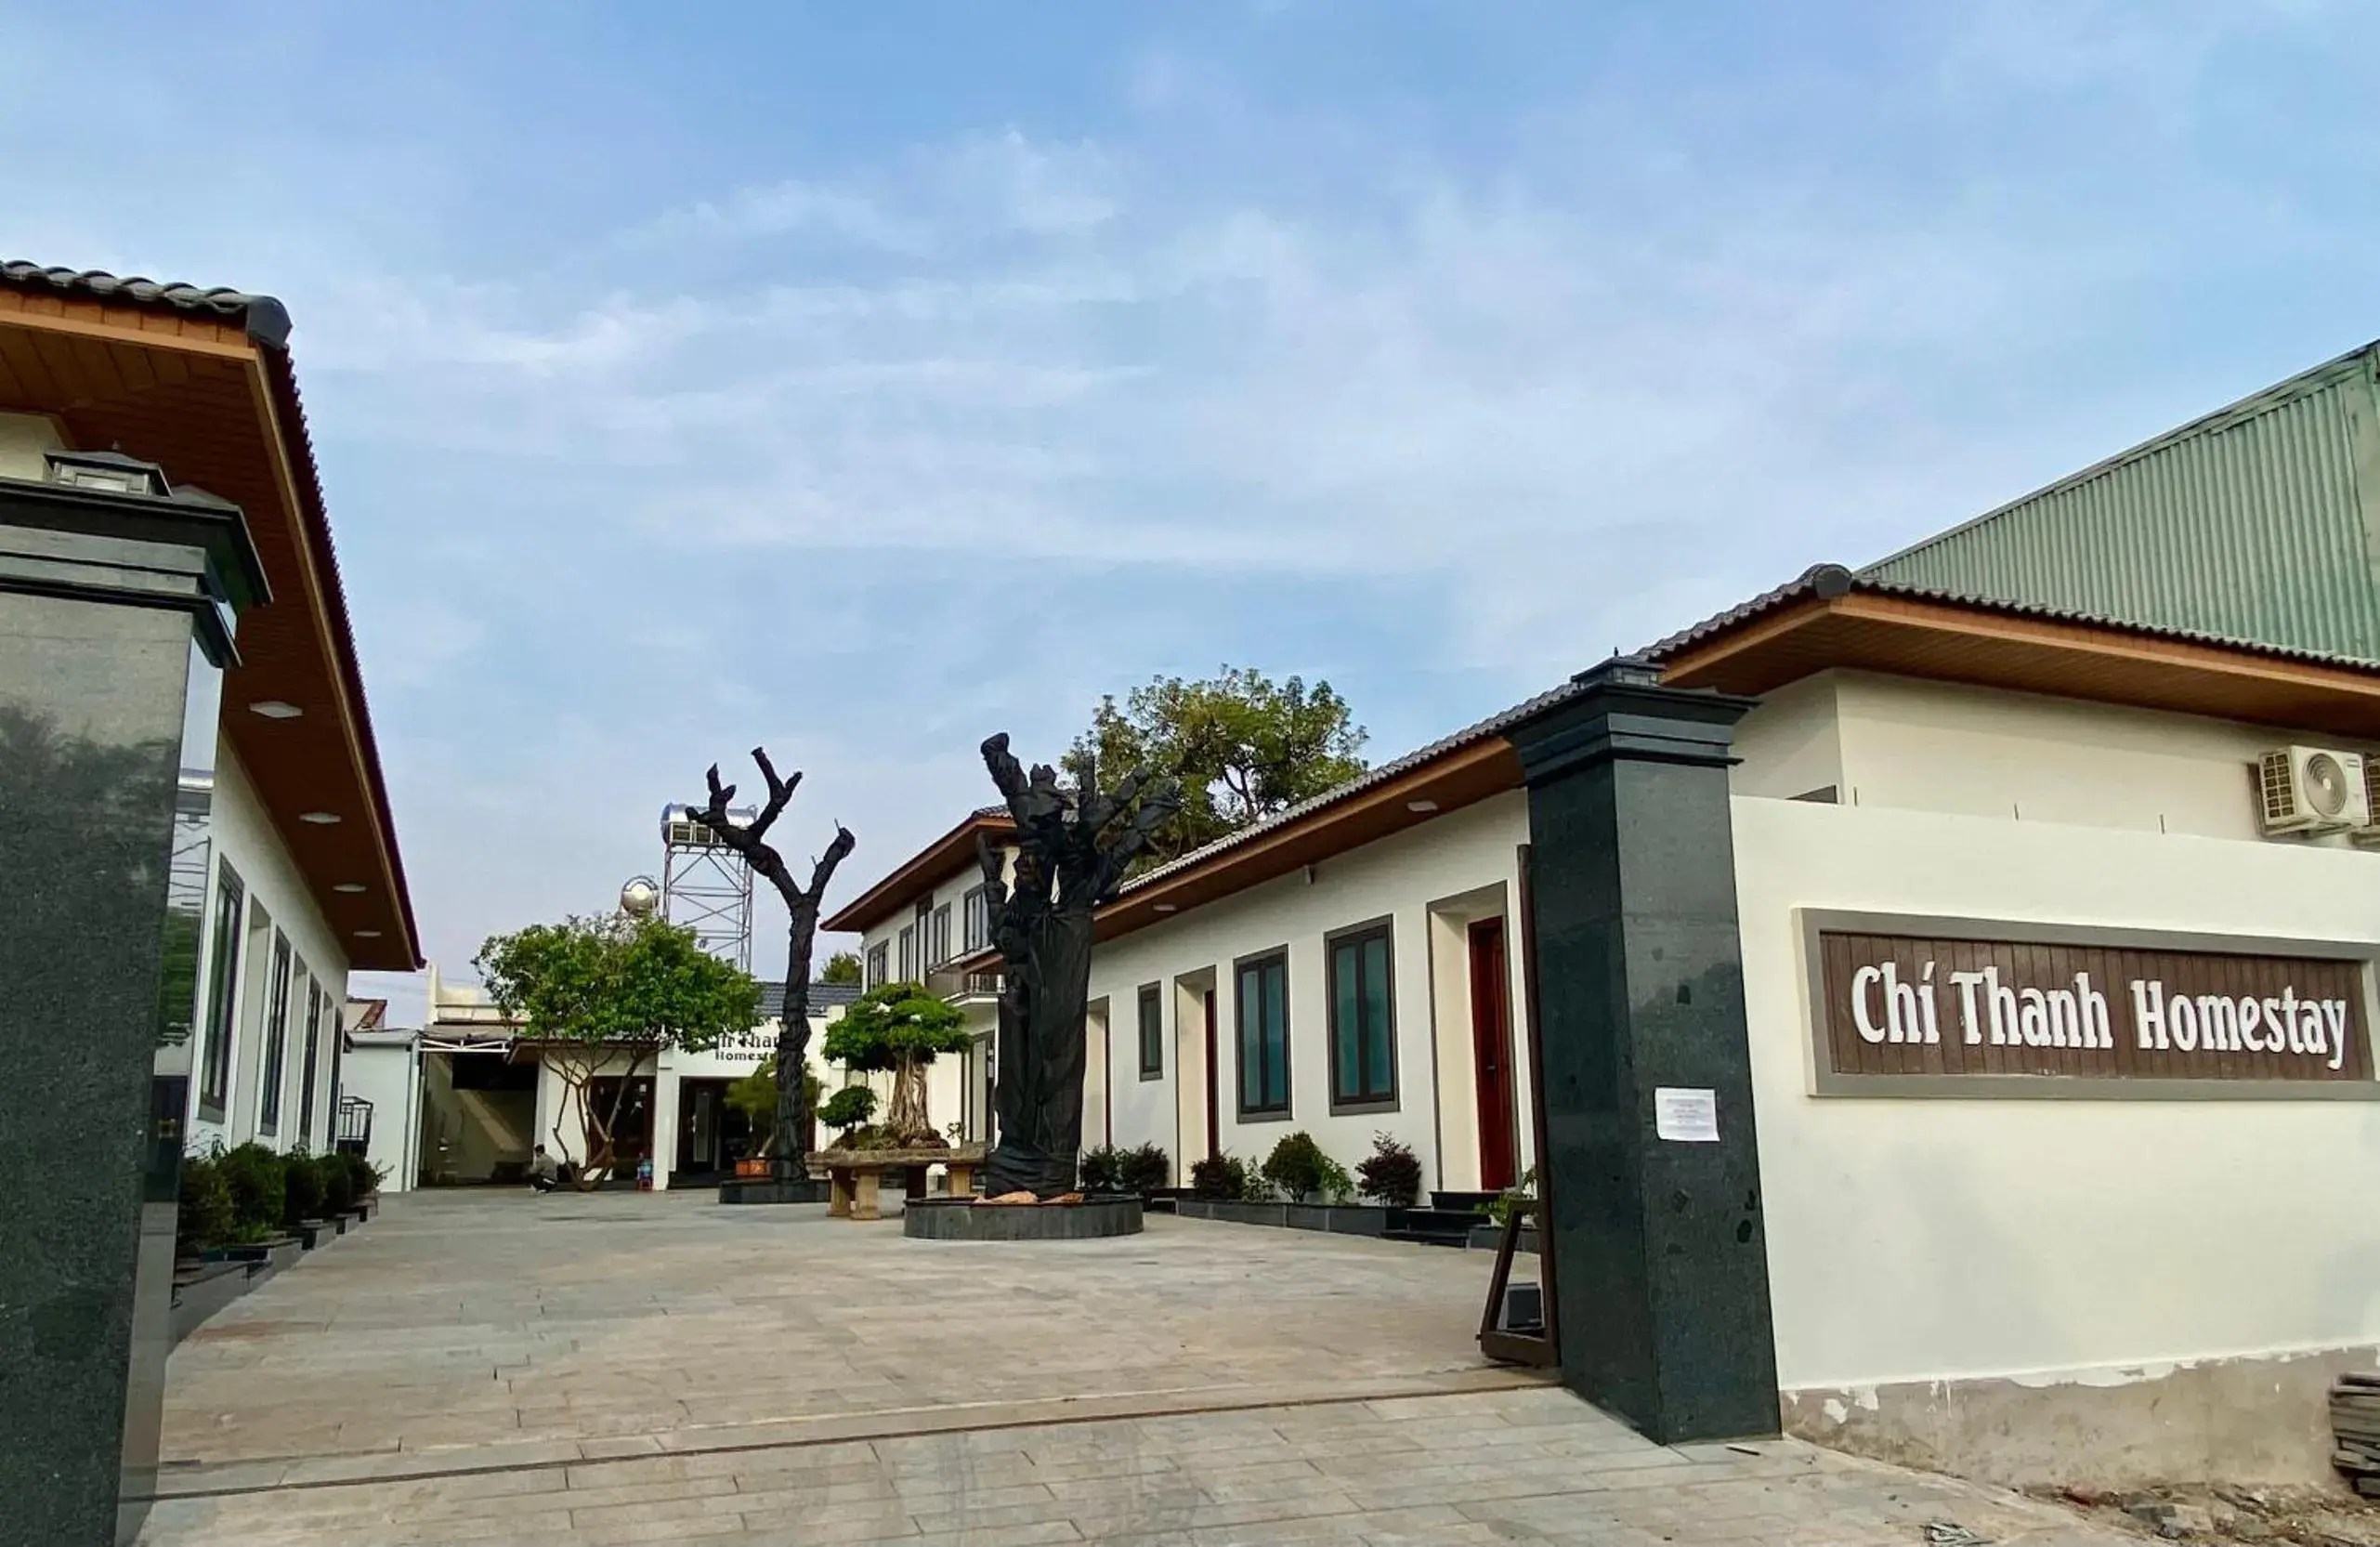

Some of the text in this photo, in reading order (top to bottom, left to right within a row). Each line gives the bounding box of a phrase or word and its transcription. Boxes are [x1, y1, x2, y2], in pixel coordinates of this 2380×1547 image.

[1851, 961, 2347, 1070] Chí Thanh Homestay
